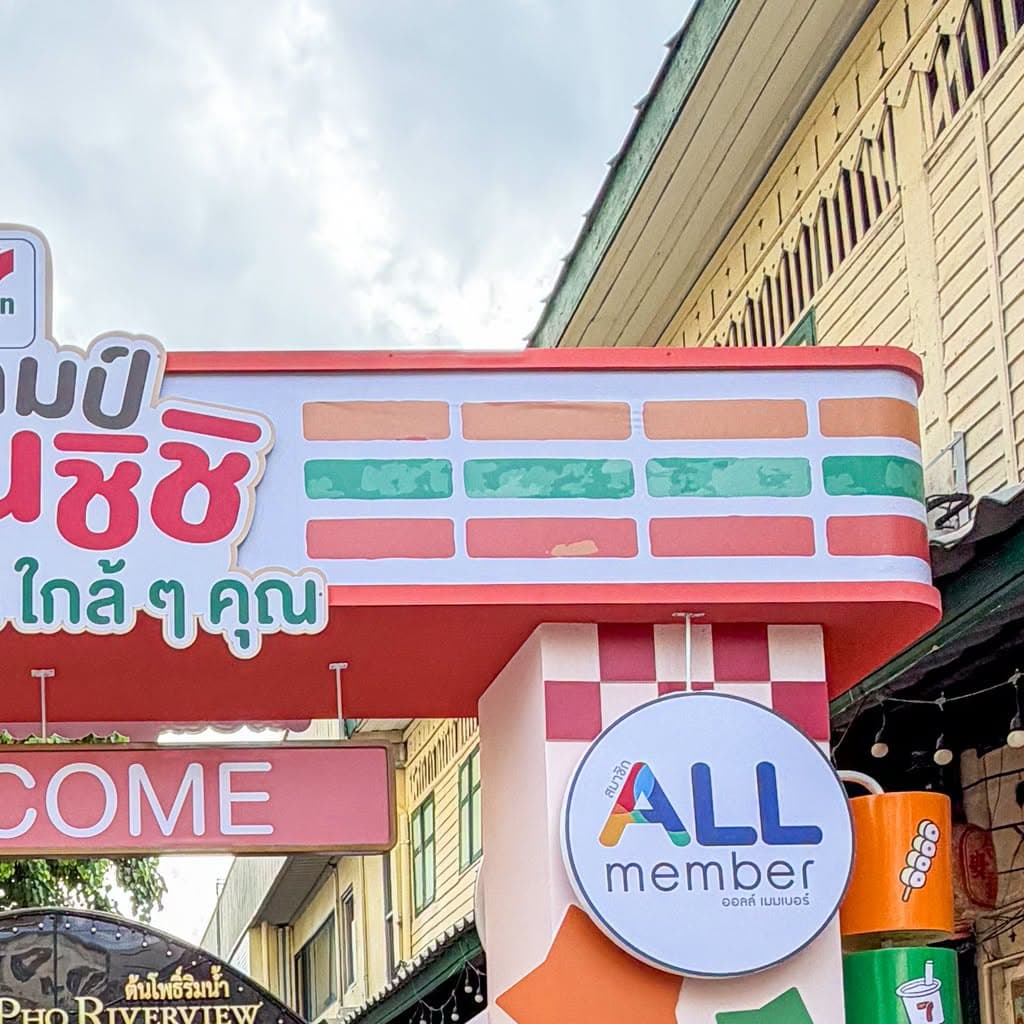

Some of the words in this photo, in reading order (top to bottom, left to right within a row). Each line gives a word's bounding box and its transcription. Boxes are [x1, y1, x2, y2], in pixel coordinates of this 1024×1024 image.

[13, 556, 125, 625] ใกล้
[209, 578, 317, 650] คุณ
[604, 759, 632, 799] สมาชิก
[598, 761, 824, 848] ALL
[605, 851, 815, 893] member
[760, 892, 811, 907] เมมเบอร์
[916, 1001, 935, 1022] 7
